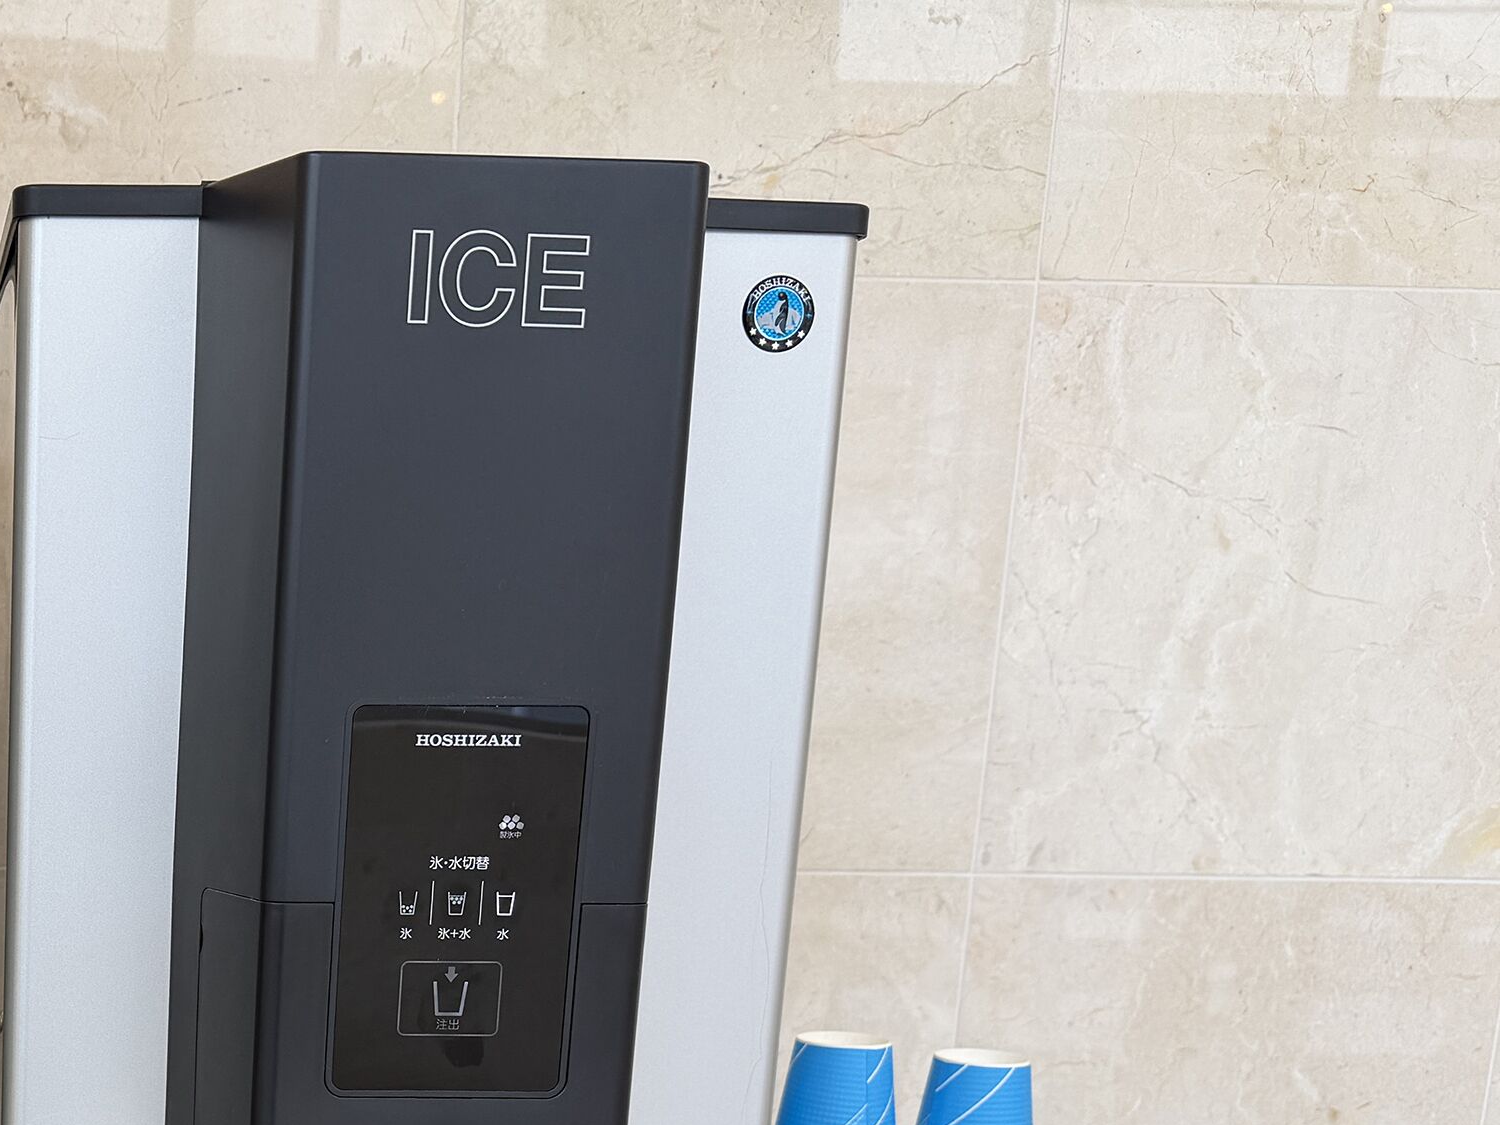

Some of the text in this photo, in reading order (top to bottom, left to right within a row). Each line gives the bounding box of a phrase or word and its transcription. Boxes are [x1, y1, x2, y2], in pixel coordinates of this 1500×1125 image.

[407, 229, 591, 329] ICE
[752, 277, 811, 303] HOSHIZAKI
[415, 734, 522, 748] HOSHIZAKI
[399, 927, 510, 941] 氷 氷+水 水
[435, 1018, 460, 1031] 注出
